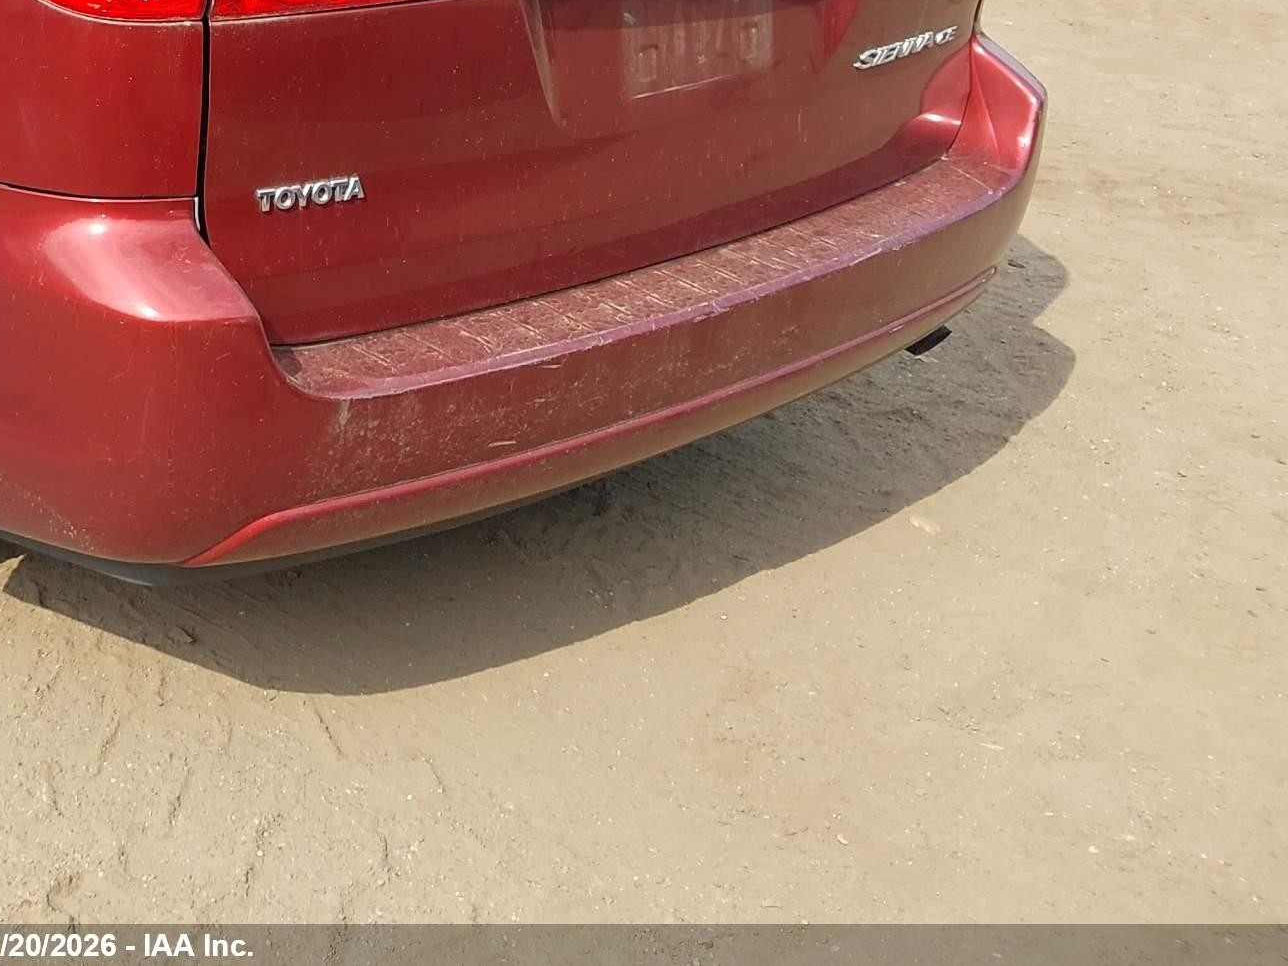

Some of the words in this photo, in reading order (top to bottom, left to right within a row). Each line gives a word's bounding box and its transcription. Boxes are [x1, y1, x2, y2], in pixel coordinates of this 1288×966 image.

[853, 31, 934, 70] SIENNA
[934, 25, 958, 46] CE
[255, 175, 365, 213] TOYOTA
